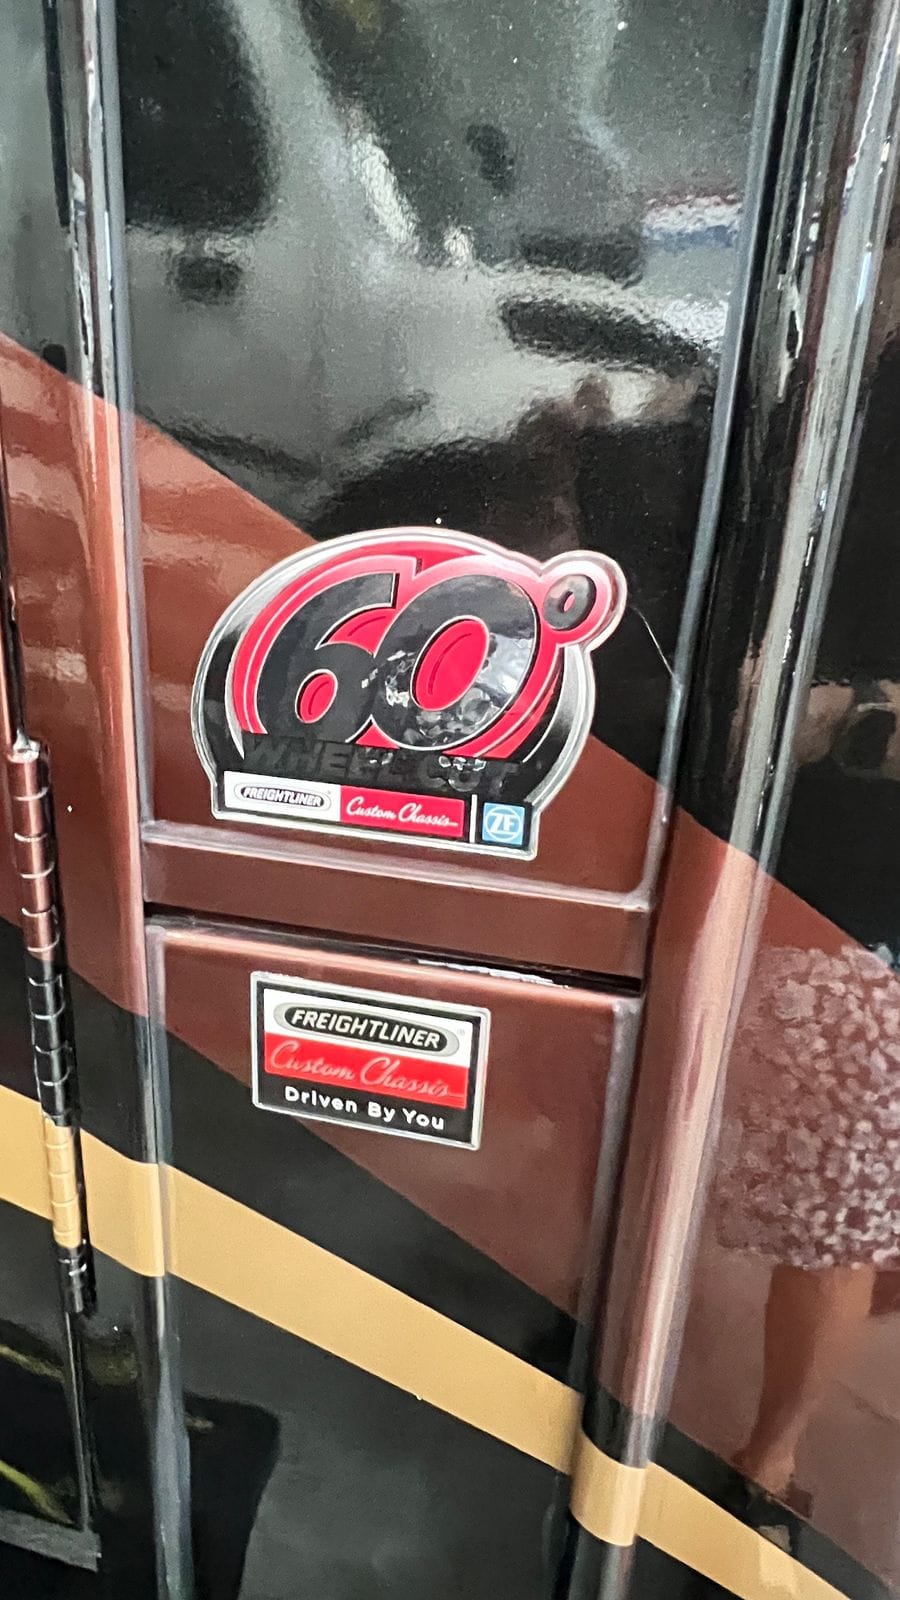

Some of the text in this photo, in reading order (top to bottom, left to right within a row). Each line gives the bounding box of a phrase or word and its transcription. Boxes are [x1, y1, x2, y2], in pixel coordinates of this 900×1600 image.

[243, 735, 407, 784] WHEEL
[243, 786, 322, 807] FREIGHTLINER
[346, 796, 457, 827] Custom Chassis
[491, 811, 515, 832] ZF
[291, 1009, 441, 1049] FREIGHTLINER
[271, 1040, 449, 1097] Custom Chassis
[284, 1085, 444, 1131] Driven By You
